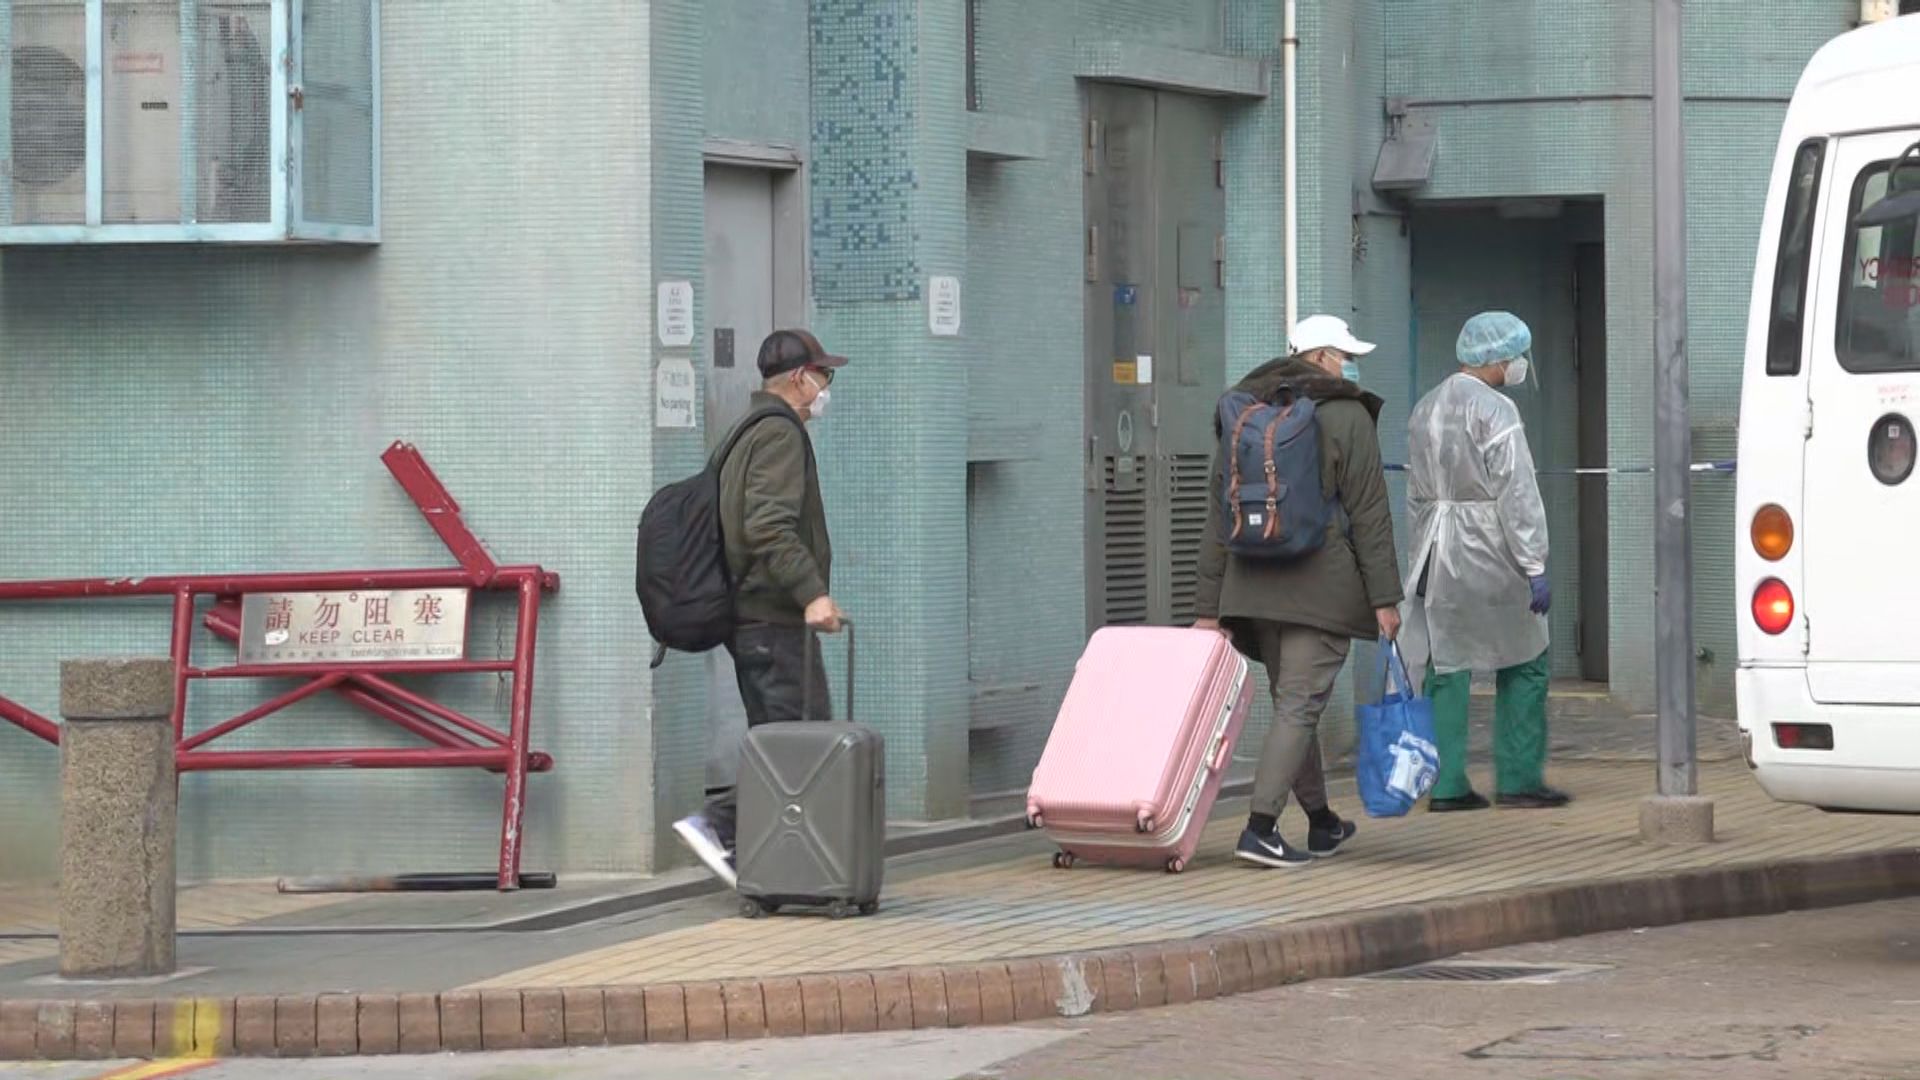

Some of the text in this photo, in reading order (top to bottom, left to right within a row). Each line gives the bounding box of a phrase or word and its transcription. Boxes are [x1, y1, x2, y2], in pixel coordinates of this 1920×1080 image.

[264, 593, 443, 630] 請勿阻塞
[299, 629, 405, 644] KEEP CLEAR
